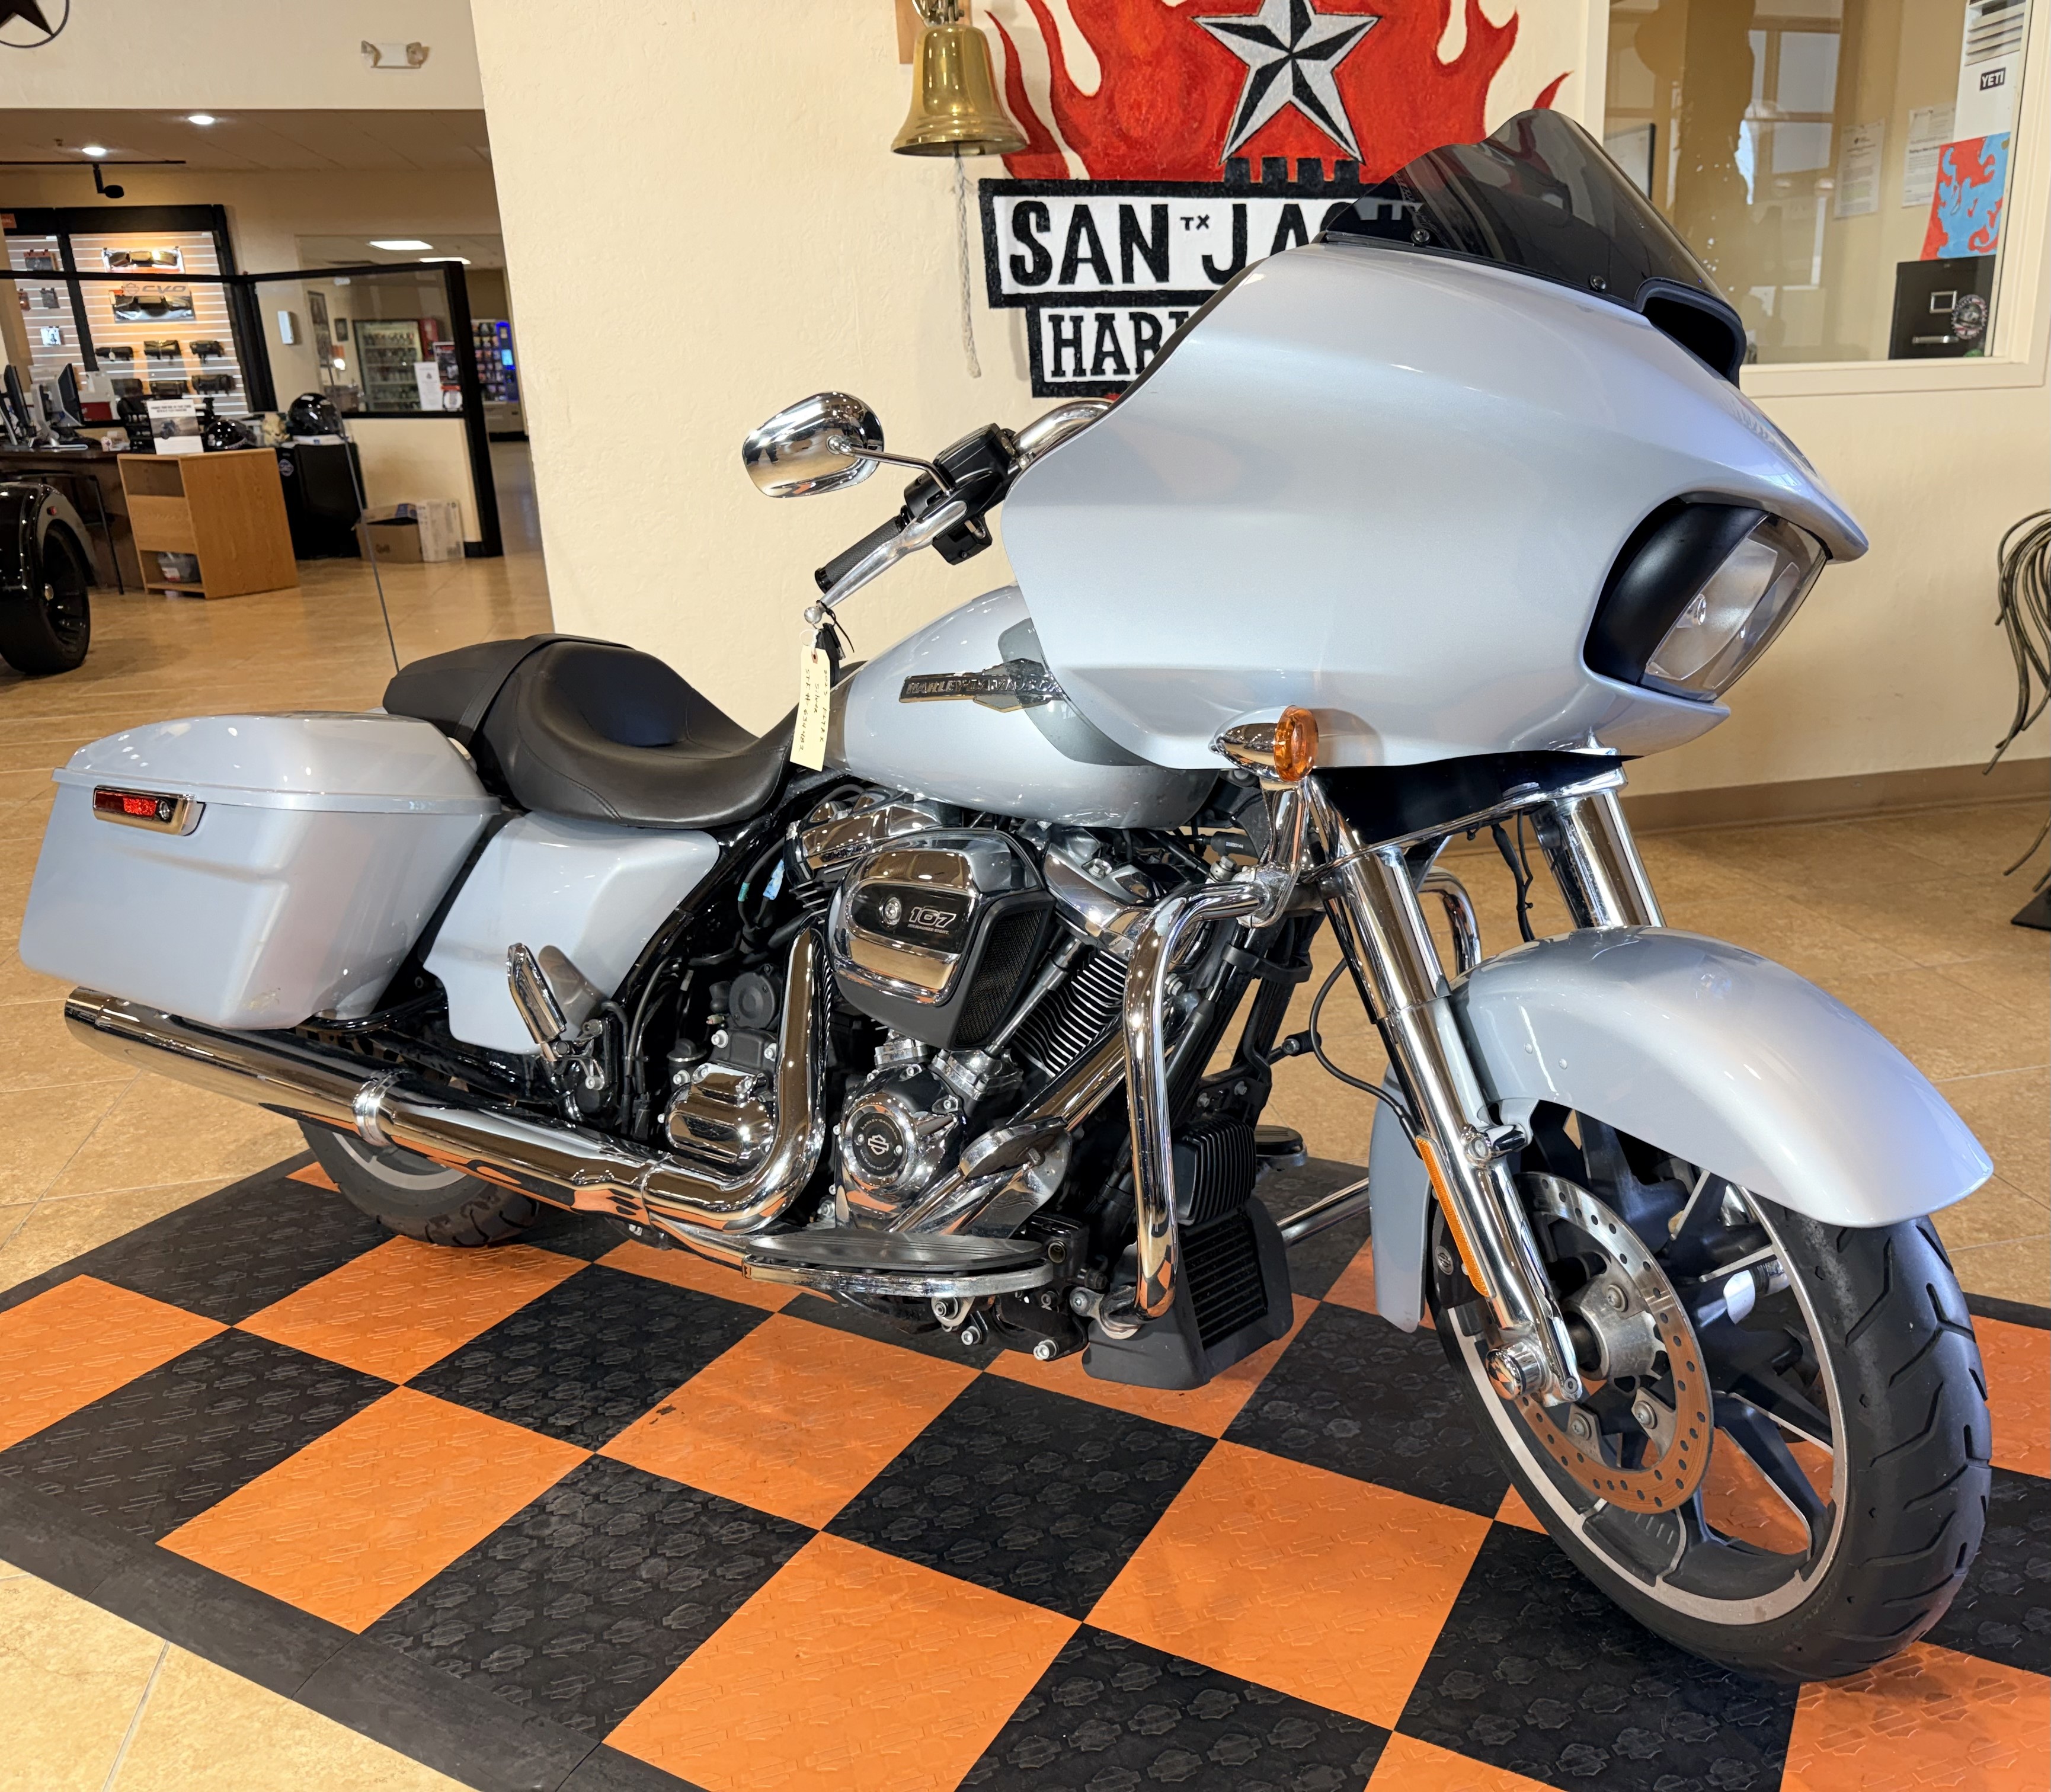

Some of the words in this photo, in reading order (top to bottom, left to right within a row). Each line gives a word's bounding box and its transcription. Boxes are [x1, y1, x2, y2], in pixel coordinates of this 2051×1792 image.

[1981, 71, 2004, 88] YETI
[1180, 214, 1210, 231] TX
[1010, 200, 1170, 286] SAN
[142, 285, 186, 294] CVO
[908, 906, 957, 929] 107
